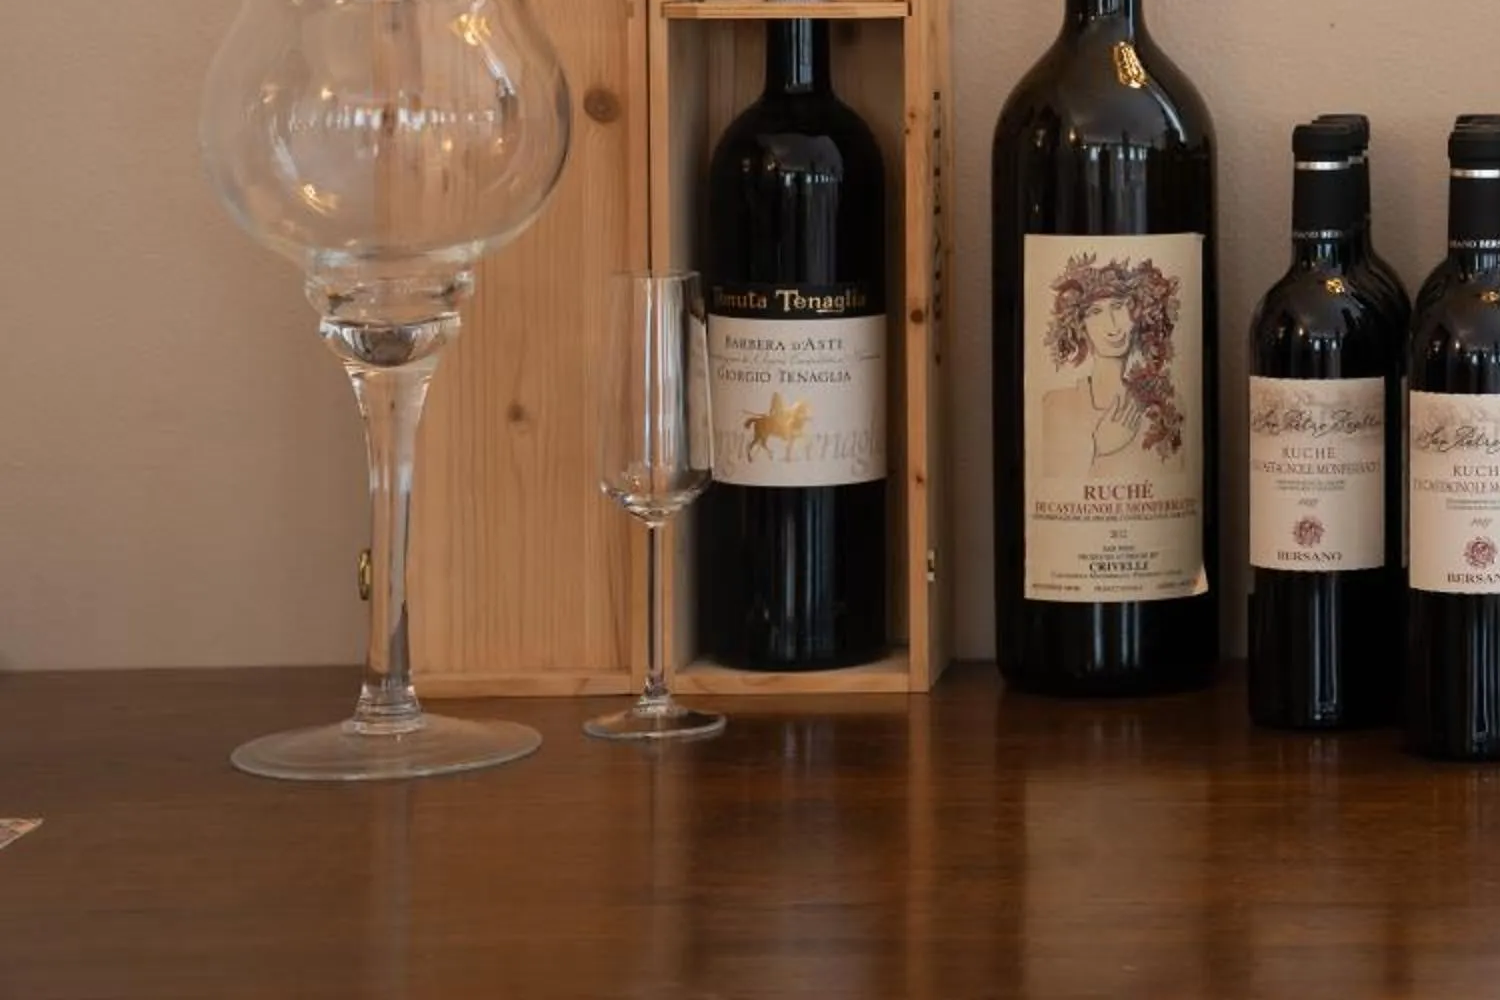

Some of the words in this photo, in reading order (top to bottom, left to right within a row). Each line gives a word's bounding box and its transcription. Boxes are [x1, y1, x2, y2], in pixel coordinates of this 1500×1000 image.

[776, 289, 867, 313] Tenaglia
[779, 370, 852, 384] TENAGLIA
[1277, 551, 1342, 561] BERSANO
